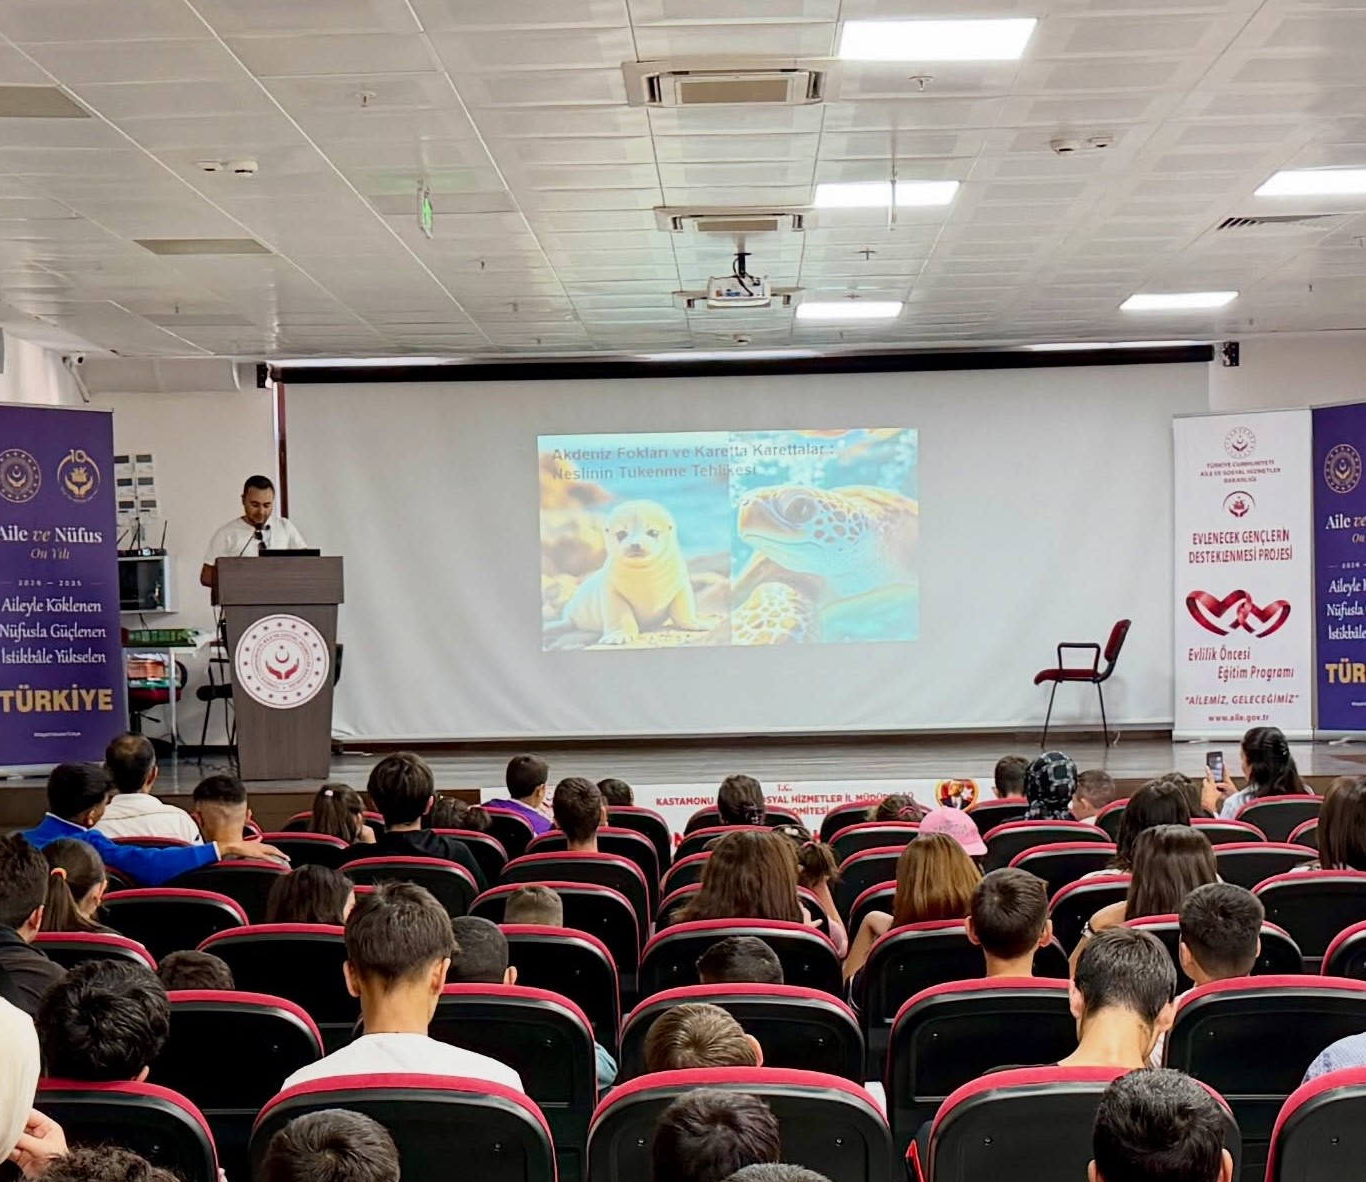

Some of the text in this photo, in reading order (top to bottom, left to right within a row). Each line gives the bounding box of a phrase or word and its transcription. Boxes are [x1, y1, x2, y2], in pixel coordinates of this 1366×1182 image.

[672, 448, 690, 458] ve
[695, 445, 748, 457] Karetta
[753, 443, 824, 456] Karettalar
[1325, 513, 1351, 529] Aile
[33, 530, 51, 542] ve
[55, 527, 103, 543] Nüfus
[1192, 531, 1240, 545] EVLENECEK
[1189, 545, 1293, 564] DESTEKLENMESİ PROJESİ
[1328, 577, 1361, 597] Aileyle
[1, 596, 102, 617] Aileyle Köklenen
[1327, 600, 1364, 621] Nüfusla
[0, 622, 107, 643] Nüfusla Güçlenen
[55, 647, 107, 664] Yükselen
[1188, 645, 1251, 661] Evlilik Öncesi
[1218, 665, 1294, 682] Eğitim Programı
[1208, 714, 1269, 723] www.aile.gov.tr
[656, 797, 714, 806] KASTAMONU
[763, 796, 789, 804] SYAL
[791, 794, 843, 804] HİZMETLER
[845, 792, 853, 802] İL
[792, 805, 829, 815] OMİTESİ
